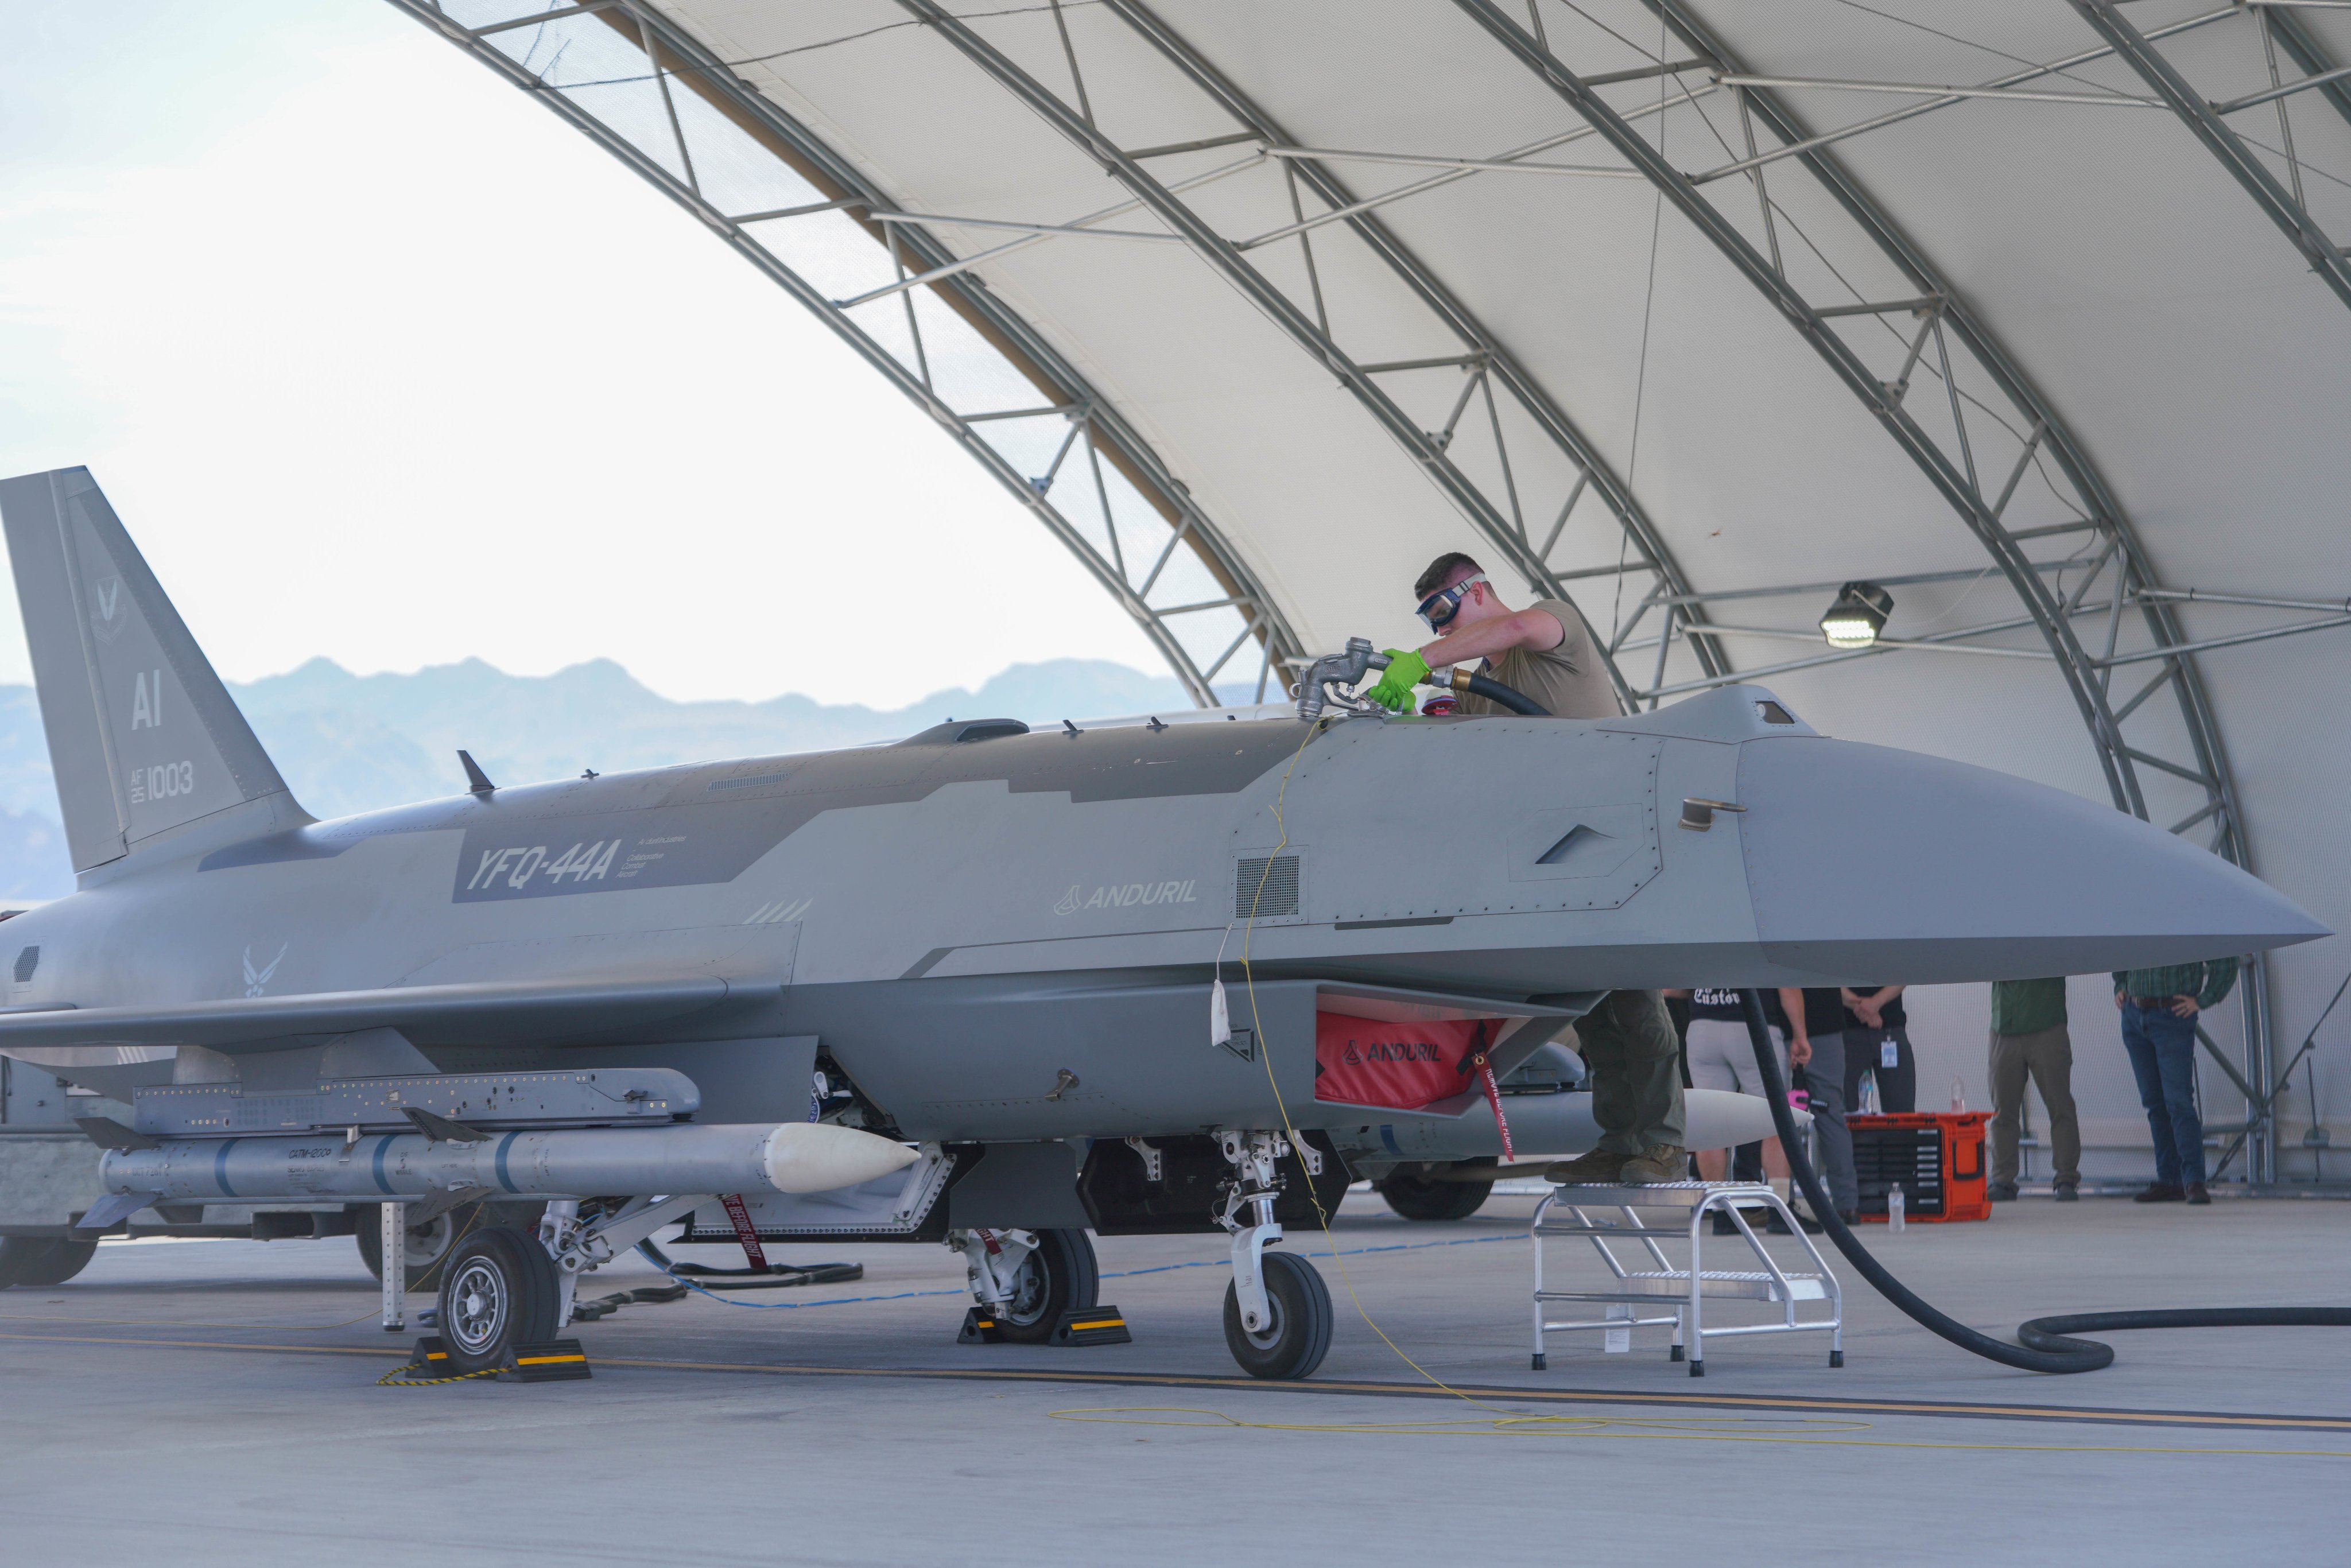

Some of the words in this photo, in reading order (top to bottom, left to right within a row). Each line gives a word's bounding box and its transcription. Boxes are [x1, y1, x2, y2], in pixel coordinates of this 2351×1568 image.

[131, 669, 160, 731] AI
[131, 769, 143, 786] AF
[148, 760, 193, 801] 1003
[131, 786, 144, 804] 25
[466, 839, 622, 890] YFQ-44A
[621, 861, 646, 870] Combat
[626, 853, 664, 861] Collaborative
[615, 870, 638, 878] Aircraft
[1083, 880, 1197, 909] ANDURIL
[1367, 1043, 1441, 1062] ANDURIL
[728, 1206, 752, 1233] BEFORE
[740, 1233, 763, 1259] FLIGHT
